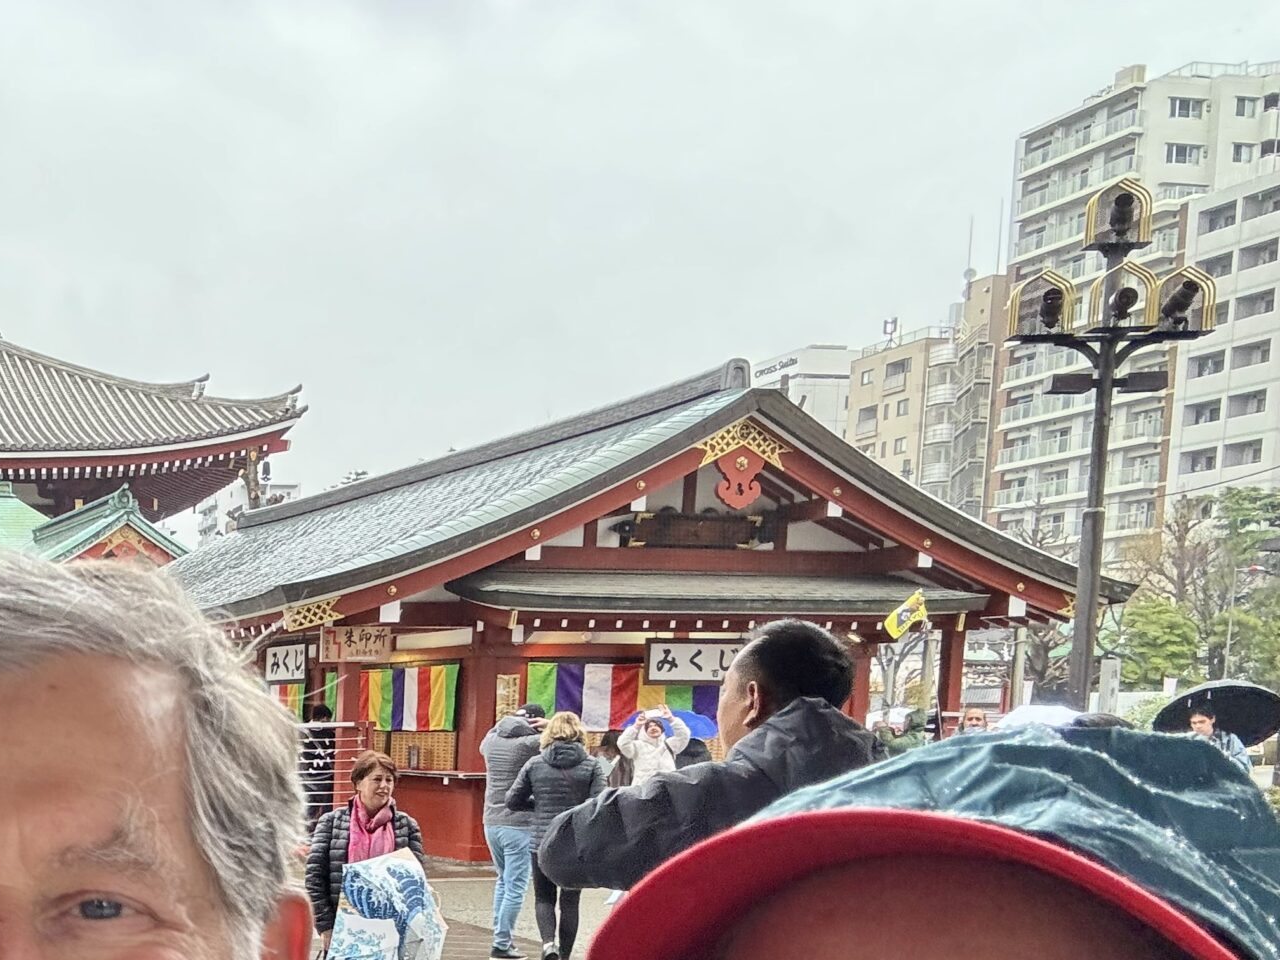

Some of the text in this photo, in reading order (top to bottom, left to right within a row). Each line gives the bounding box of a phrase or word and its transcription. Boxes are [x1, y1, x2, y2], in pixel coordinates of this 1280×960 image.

[344, 628, 388, 648] 朱印所
[270, 649, 303, 675] みくじ
[656, 648, 738, 673] みくじ
